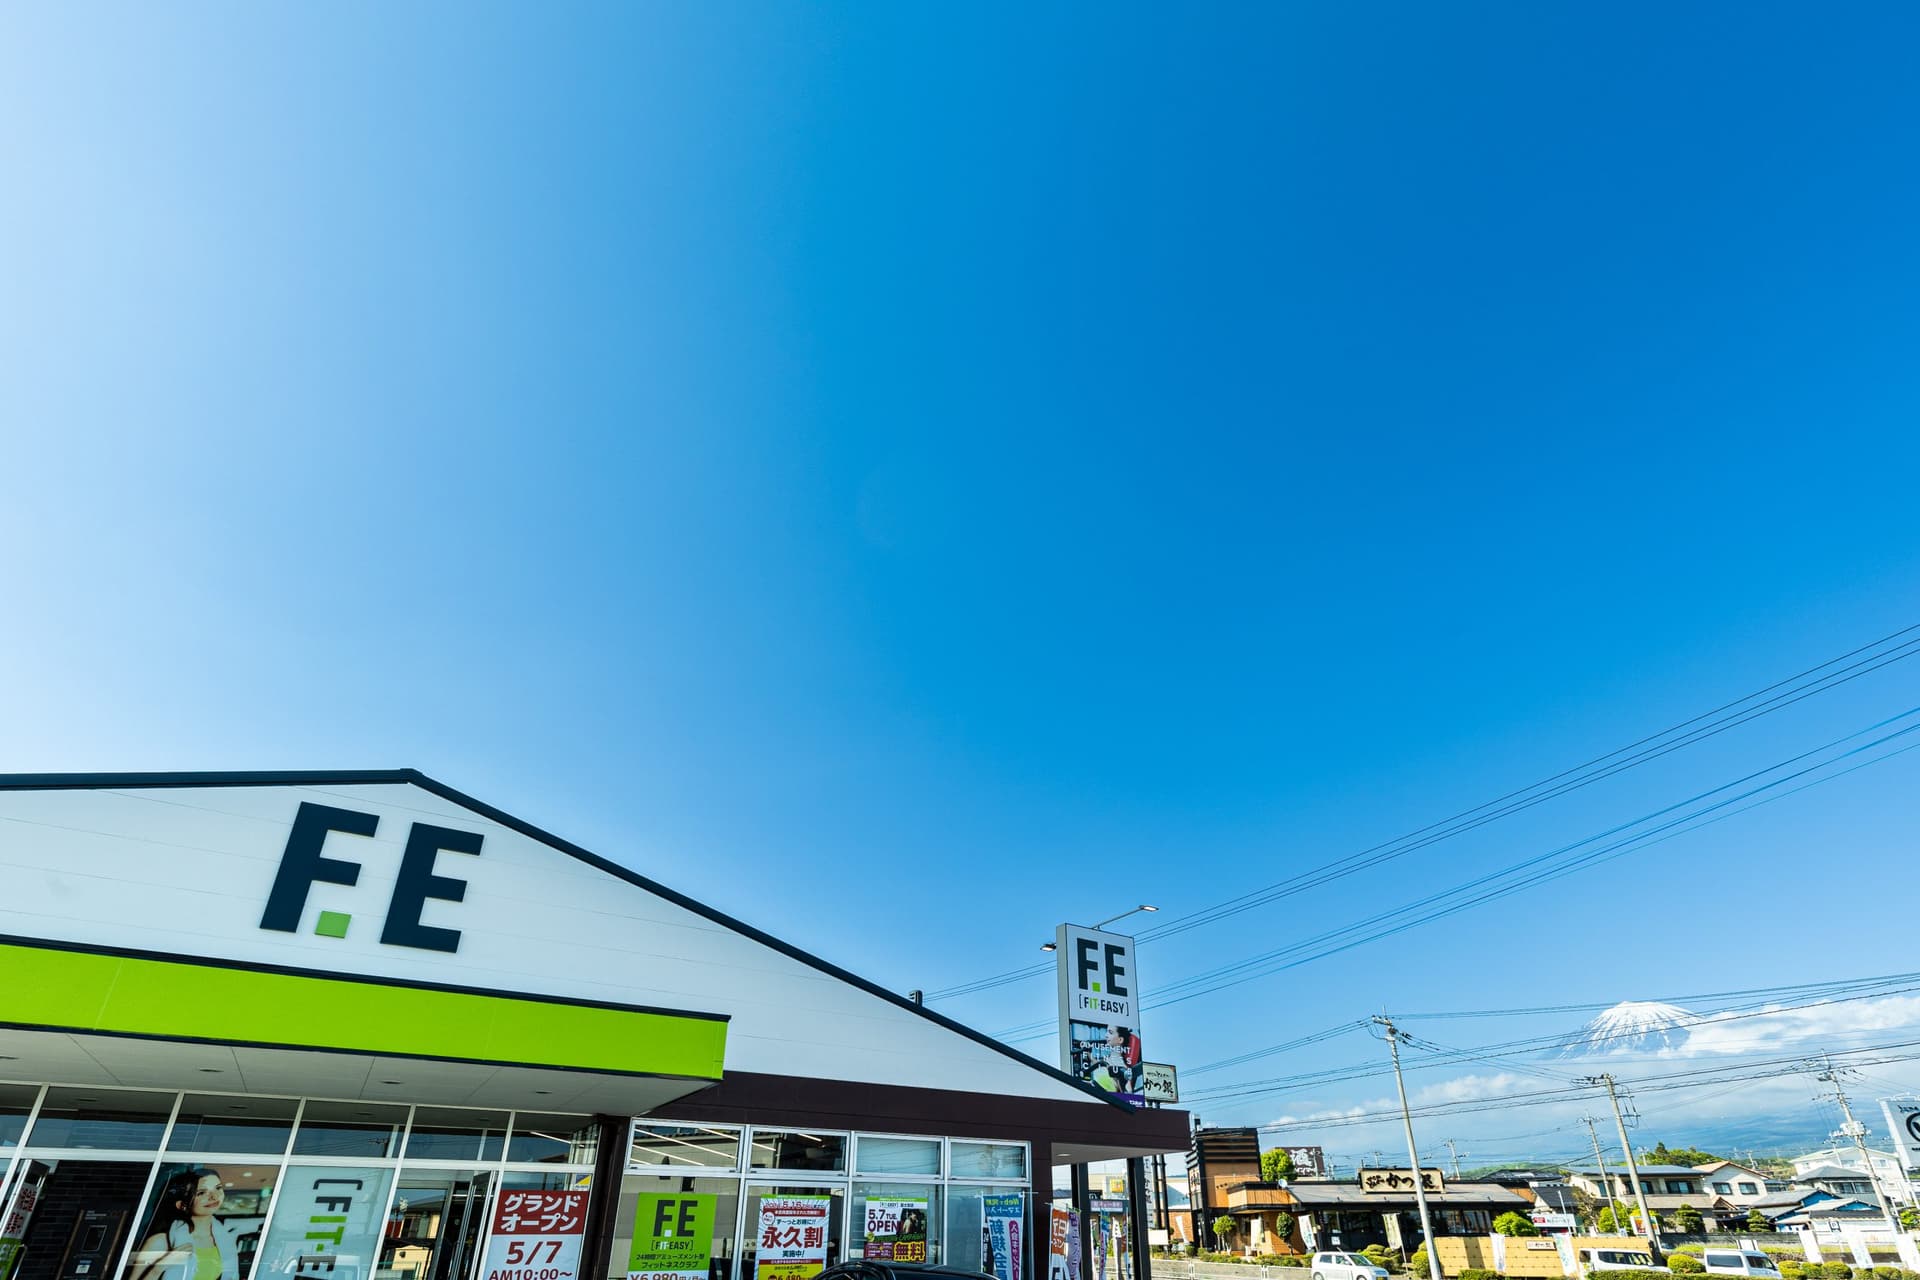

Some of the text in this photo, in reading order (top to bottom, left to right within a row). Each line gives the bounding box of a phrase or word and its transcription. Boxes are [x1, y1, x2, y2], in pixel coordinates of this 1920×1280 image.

[505, 1193, 581, 1213] グランド
[500, 1213, 578, 1232] オープン
[868, 1209, 886, 1220] 5.7
[867, 1220, 900, 1232] OPEN
[761, 1226, 824, 1249] 永久割
[506, 1241, 563, 1265] 5/7
[894, 1241, 925, 1261] 無料
